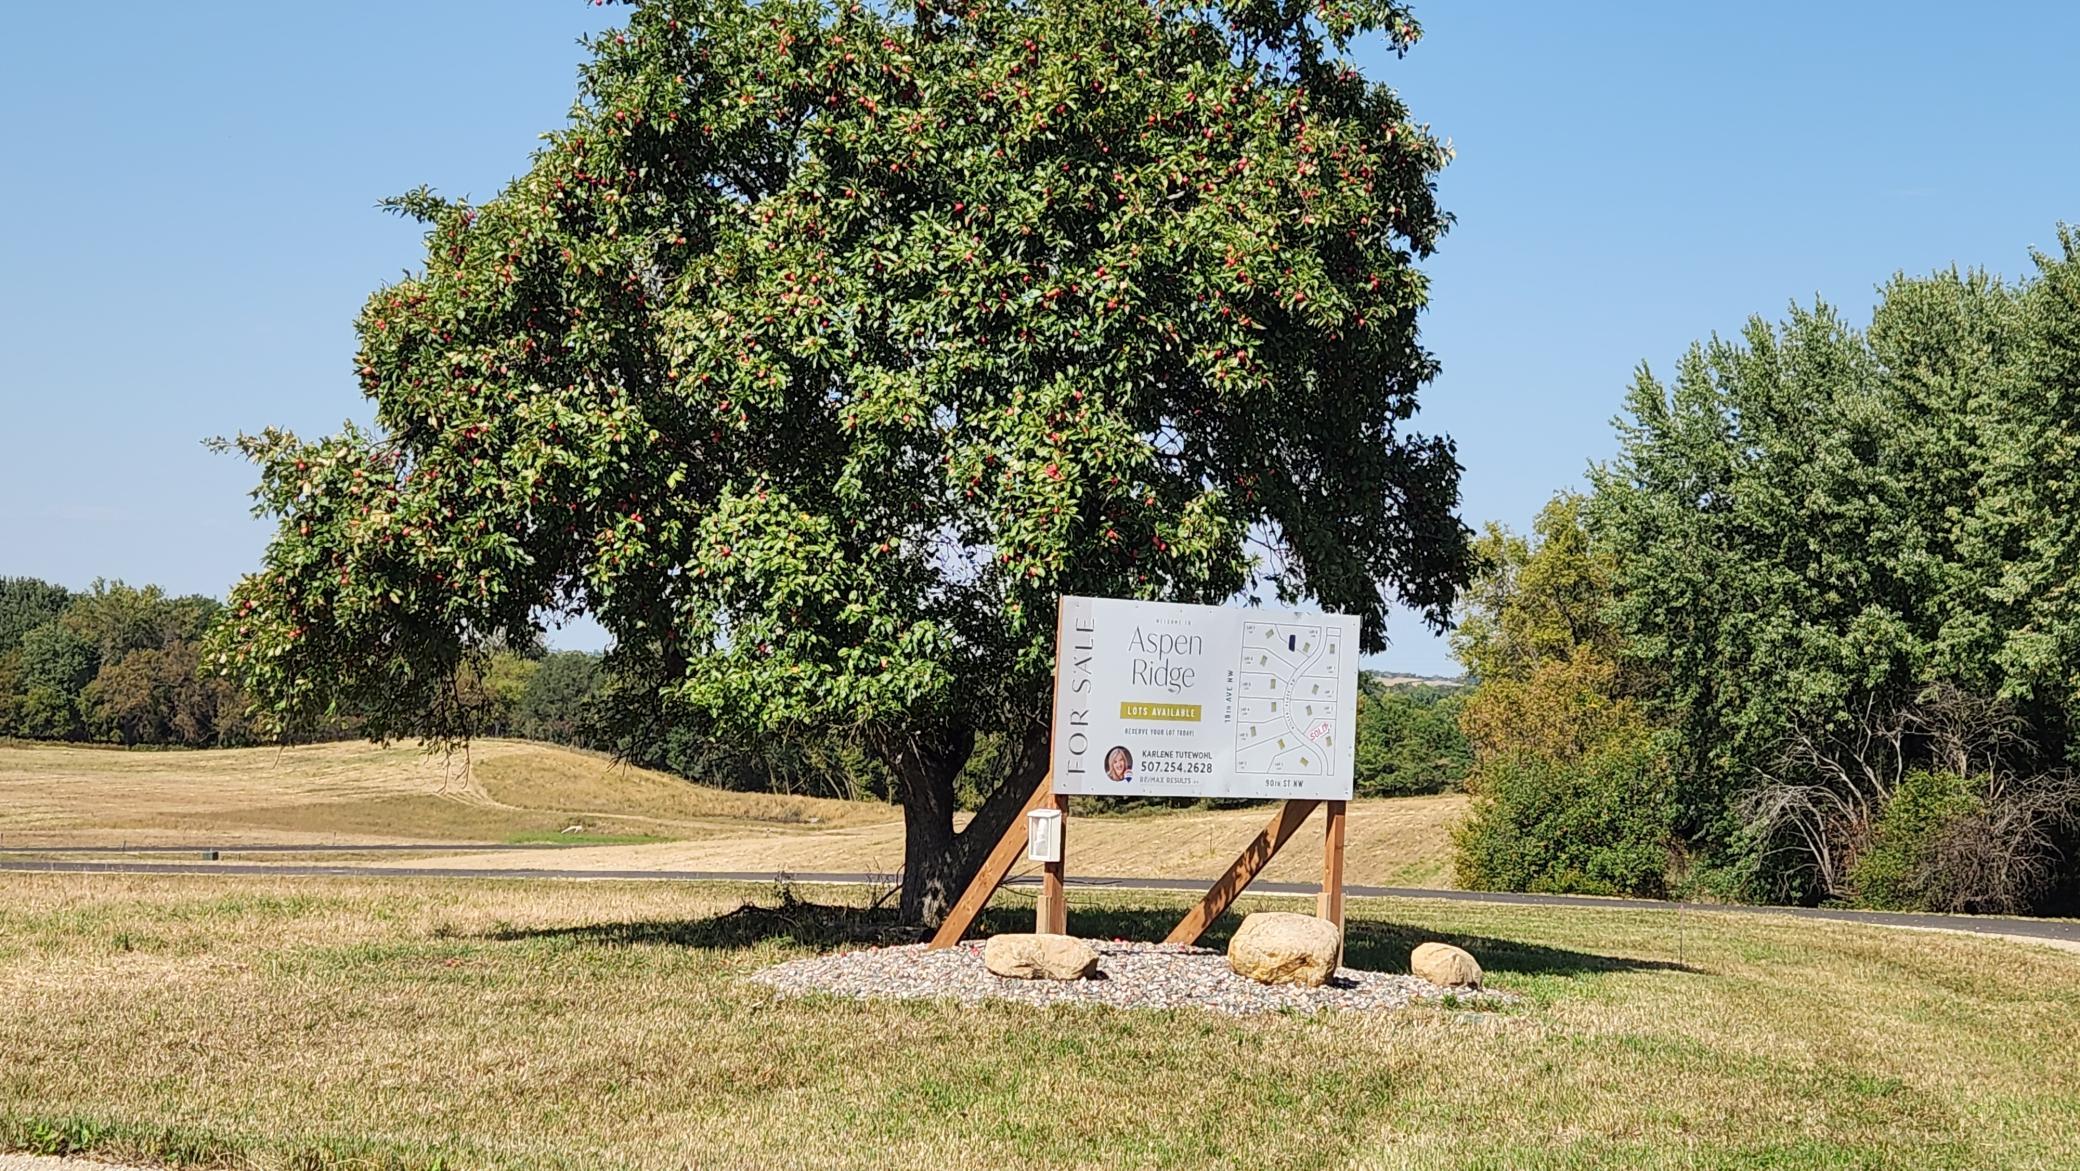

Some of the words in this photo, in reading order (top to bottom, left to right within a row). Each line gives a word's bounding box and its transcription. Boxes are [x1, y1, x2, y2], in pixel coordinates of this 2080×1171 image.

[1128, 625, 1203, 661] Aspen
[1072, 617, 1096, 694] SALE
[1132, 658, 1196, 694] Ridge
[1226, 670, 1234, 683] NW
[1225, 686, 1233, 703] AVE
[1127, 705, 1148, 716] LOTS
[1151, 706, 1196, 718] AVAILABLE
[1124, 727, 1148, 736] RESERVE
[1150, 728, 1164, 737] YOUR
[1165, 728, 1175, 737] LOT
[1067, 708, 1090, 774] FOR
[1142, 750, 1174, 760] KARLENE
[1175, 751, 1213, 760] TUTEWOHL
[1140, 761, 1213, 774] 507.254.2628
[1166, 777, 1192, 785] RESULTS
[1283, 779, 1291, 788] ST
[1293, 779, 1304, 788] NW
